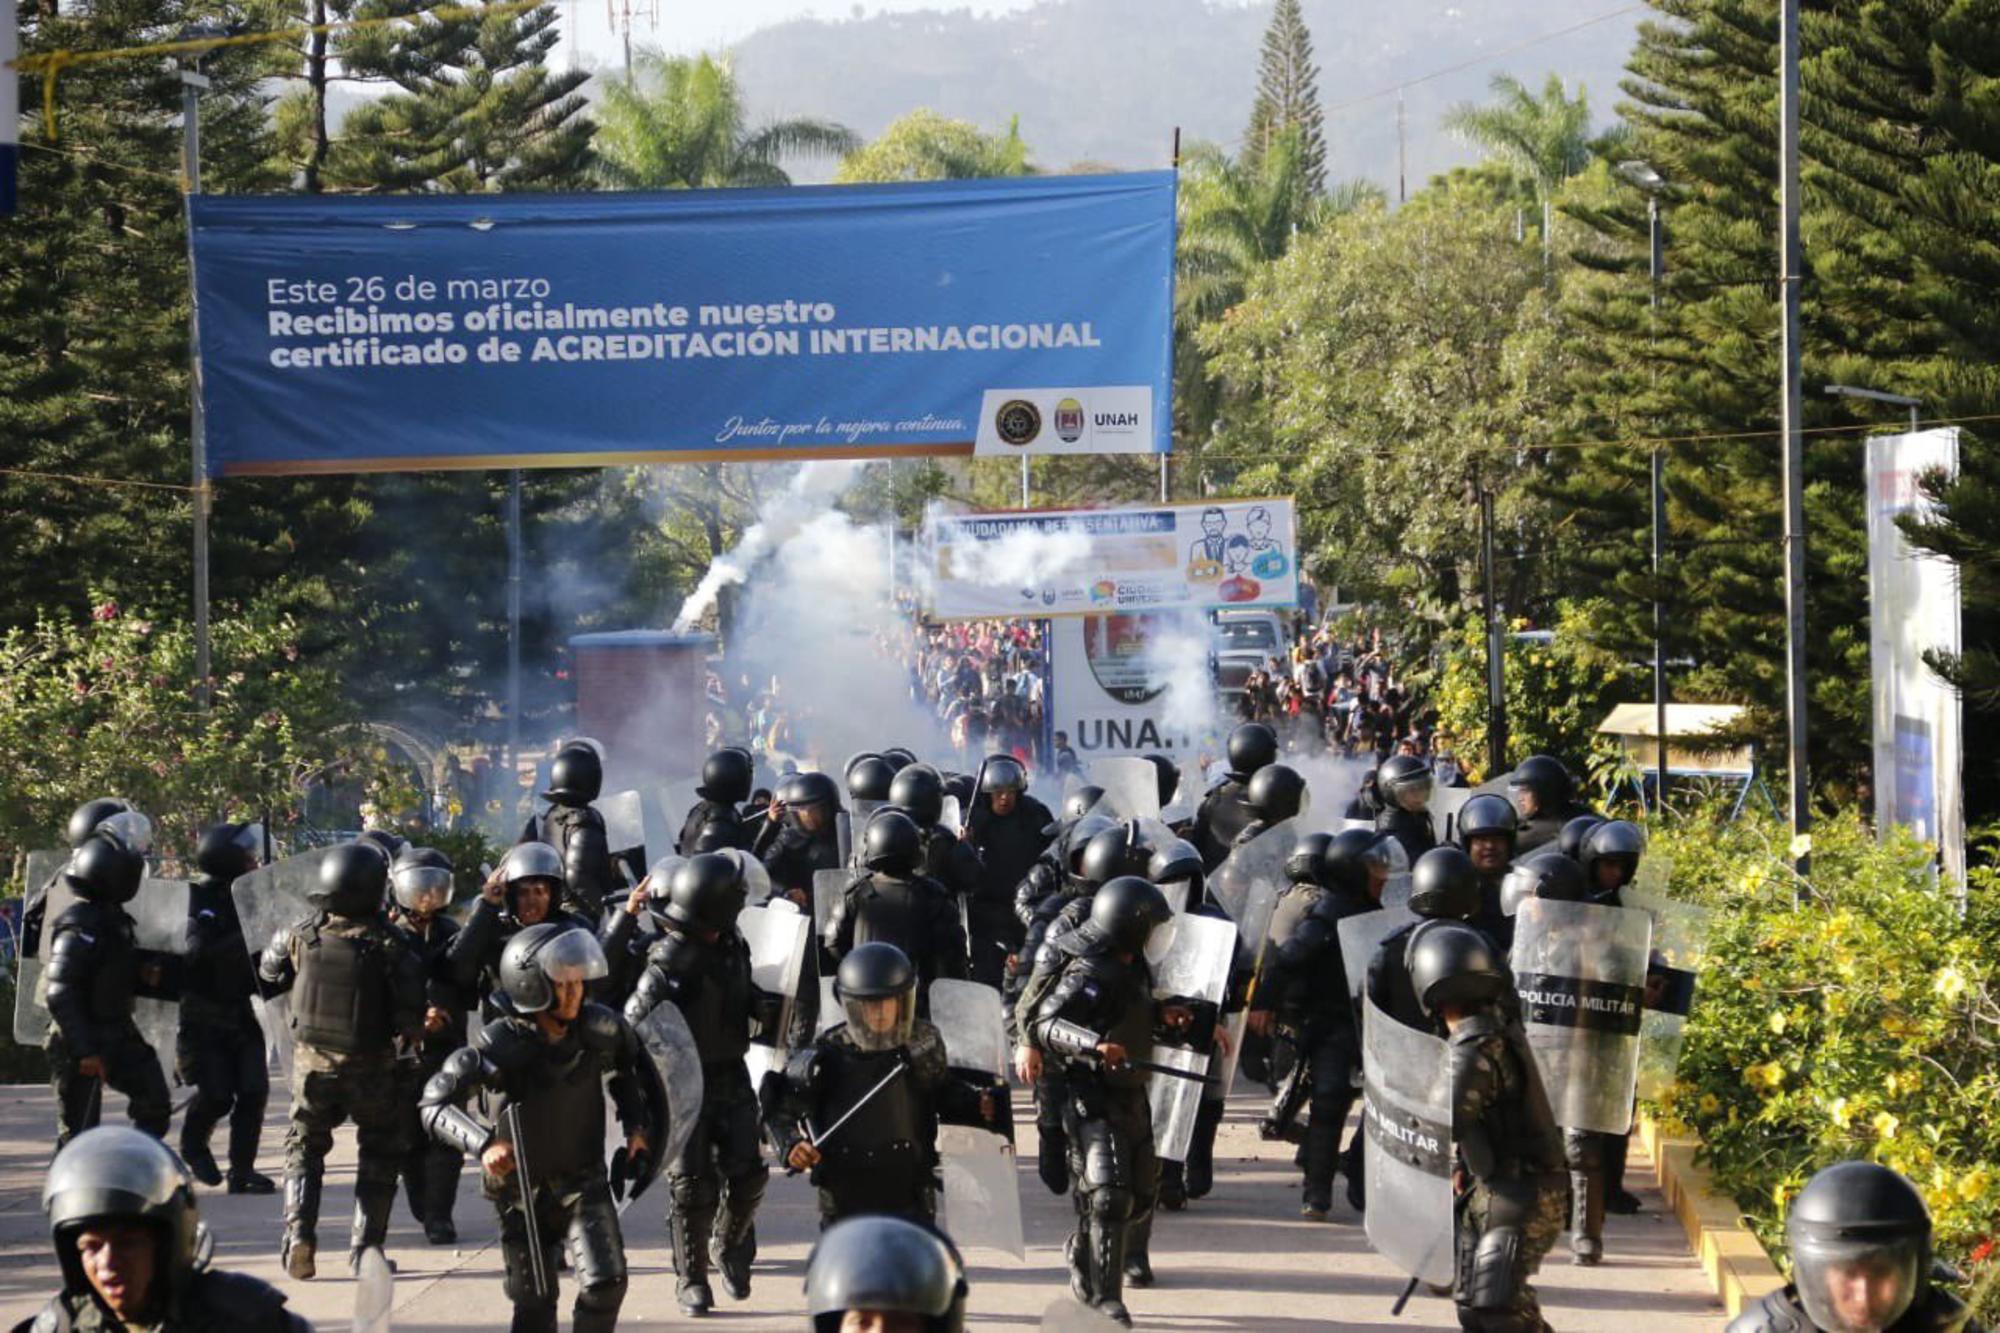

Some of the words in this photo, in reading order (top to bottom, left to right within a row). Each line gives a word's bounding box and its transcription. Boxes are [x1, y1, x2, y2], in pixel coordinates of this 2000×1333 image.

[267, 279, 337, 303] Este
[345, 276, 386, 302] 26
[395, 275, 437, 300] de
[447, 278, 550, 299] marzo
[268, 305, 455, 336] Recibimos
[464, 301, 689, 331] oficialmente
[699, 300, 836, 325] nuestro
[269, 337, 468, 368] certificado
[477, 337, 522, 362] de
[531, 325, 800, 362] ACREDITACIÓN
[809, 322, 1101, 354] INTERNACIONAL
[715, 415, 778, 443] Juntos
[778, 423, 811, 445] por
[815, 416, 832, 434] la
[836, 419, 889, 443] mejora
[1094, 413, 1138, 426] UNAH
[1077, 718, 1190, 751] UNA
[1518, 989, 1576, 1008] POLICIA
[1581, 996, 1635, 1015] MILITAR
[1379, 1111, 1439, 1154] MILITAR
